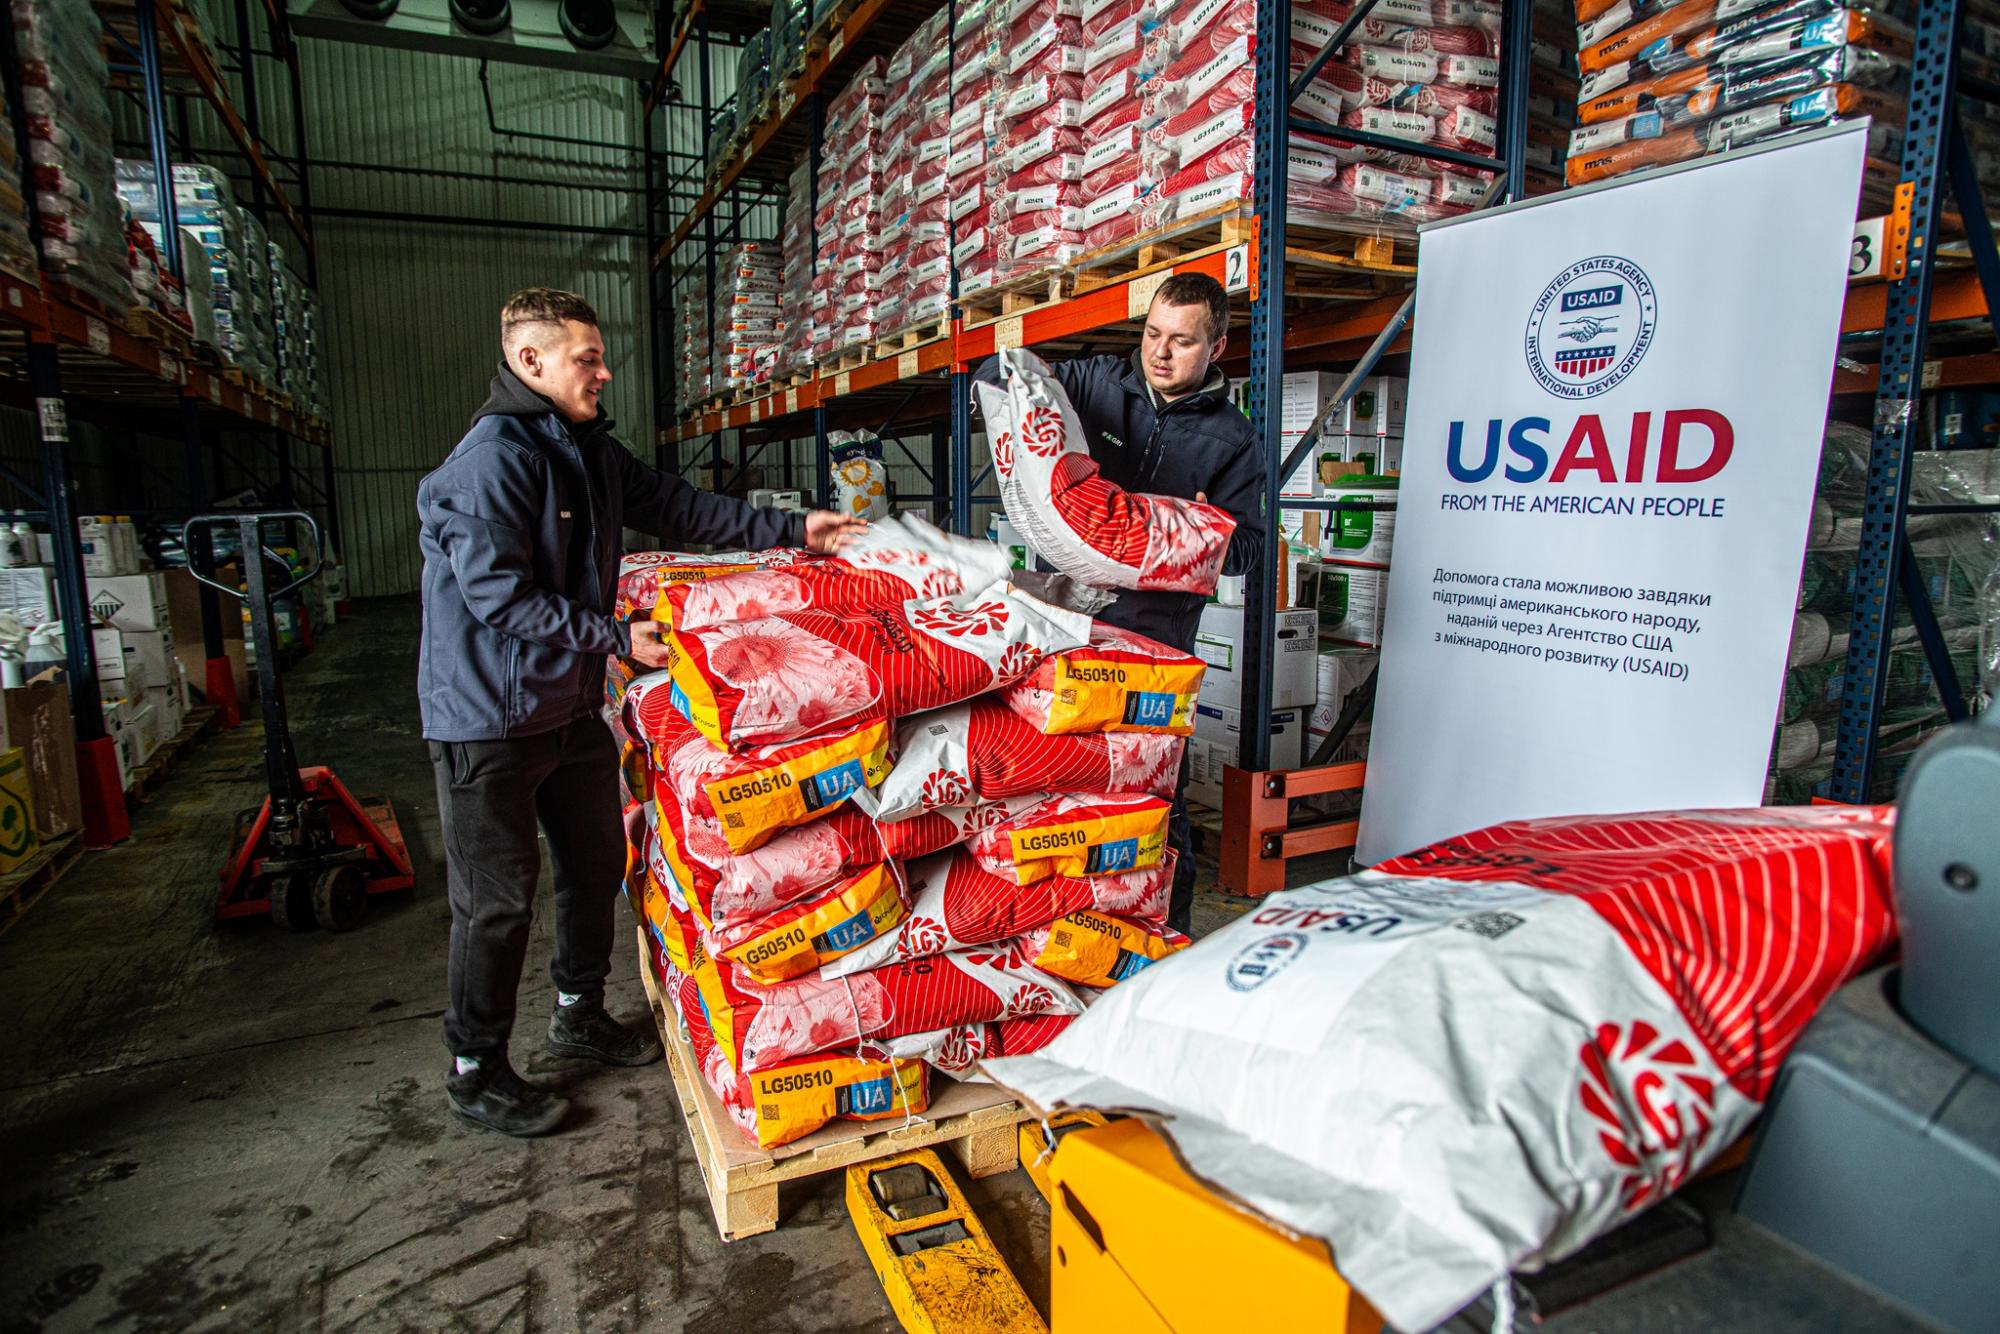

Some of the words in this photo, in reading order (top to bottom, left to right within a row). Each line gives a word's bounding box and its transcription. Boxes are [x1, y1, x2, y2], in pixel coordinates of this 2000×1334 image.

[1197, 54, 1229, 82] LG31479
[1193, 120, 1225, 144] LG31479
[1189, 188, 1222, 203] LG31479
[1849, 234, 1873, 276] 3
[1227, 250, 1242, 287] 2
[1536, 272, 1571, 313] UNITED
[1572, 259, 1615, 276] STATES
[1614, 261, 1652, 298] AGENCY
[1567, 289, 1616, 308] USAID
[1528, 335, 1584, 397] INTERNATIONAL
[1586, 320, 1653, 395] DEVELOPMENT
[1446, 408, 1735, 484] USAID
[1440, 494, 1487, 511] FROM
[1492, 495, 1526, 512] THE
[1529, 496, 1634, 515] AMERICAN
[1641, 498, 1726, 517] PEOPLE
[663, 571, 706, 582] LG50510
[1433, 568, 1499, 587] Допомога
[1502, 576, 1542, 591] стала
[1545, 580, 1633, 600] можливою
[1637, 588, 1712, 607] завдяки
[1432, 589, 1497, 609] підтримці
[1500, 598, 1628, 623] американського
[1632, 613, 1702, 634] народу,
[1446, 612, 1499, 630] наданій
[1502, 620, 1543, 638] через
[1546, 623, 1627, 647] Агентство
[1632, 633, 1674, 653] США
[1434, 631, 1442, 643] з
[1443, 633, 1542, 658] міжнародного
[1545, 648, 1619, 673] розвитку
[1622, 655, 1690, 682] (USAID)
[1066, 665, 1126, 683] LG50510
[1141, 698, 1167, 719] UA
[718, 772, 793, 804] LG50510
[822, 771, 859, 797] UA
[1021, 829, 1087, 851] LG50510
[1105, 846, 1131, 867] UA
[832, 922, 868, 948] UA
[1252, 907, 1404, 937] USAID
[761, 1069, 833, 1095] LG50510
[855, 1086, 886, 1110] UA
